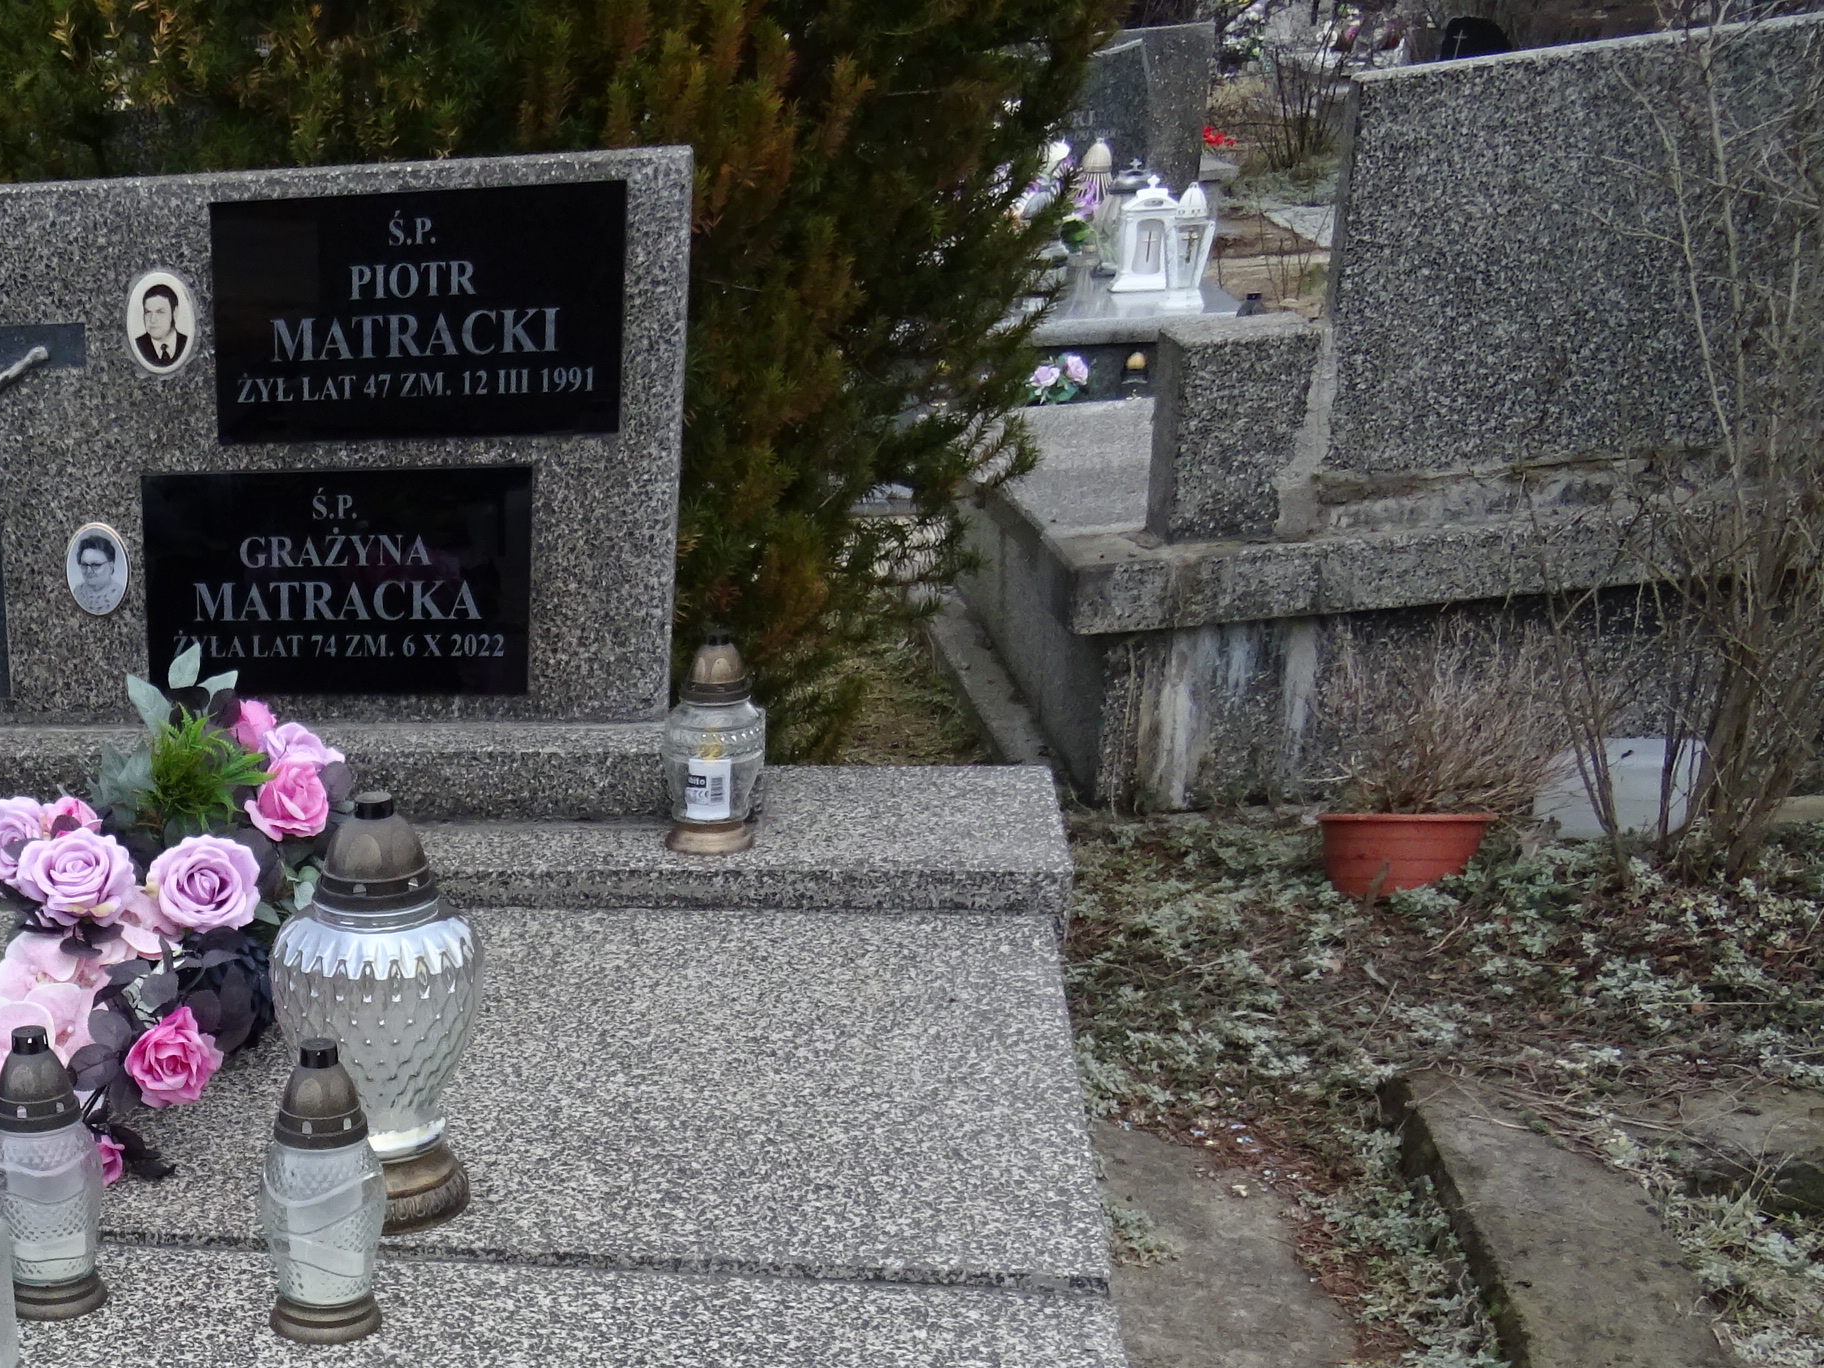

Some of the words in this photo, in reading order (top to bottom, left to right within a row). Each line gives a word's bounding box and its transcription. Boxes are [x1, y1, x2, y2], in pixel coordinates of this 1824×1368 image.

[388, 210, 437, 246] Ś.P.
[349, 260, 476, 300] PIOTR
[270, 307, 560, 362] MATRACKI
[237, 372, 294, 403] ŻYŁ
[301, 375, 356, 401] LAT
[363, 373, 391, 399] 47
[399, 371, 452, 397] ZM.
[462, 369, 488, 395] 12
[496, 368, 530, 394] III
[540, 366, 594, 393] 1991
[312, 487, 357, 520] Ś.P.
[239, 527, 432, 568] GRAŻYNA
[192, 580, 482, 621] MATRACKA
[251, 635, 304, 657] LAT
[311, 634, 338, 657] 74
[345, 634, 394, 657] ZM.
[402, 634, 416, 657] 6
[423, 634, 442, 657] X
[450, 633, 504, 657] 2022
